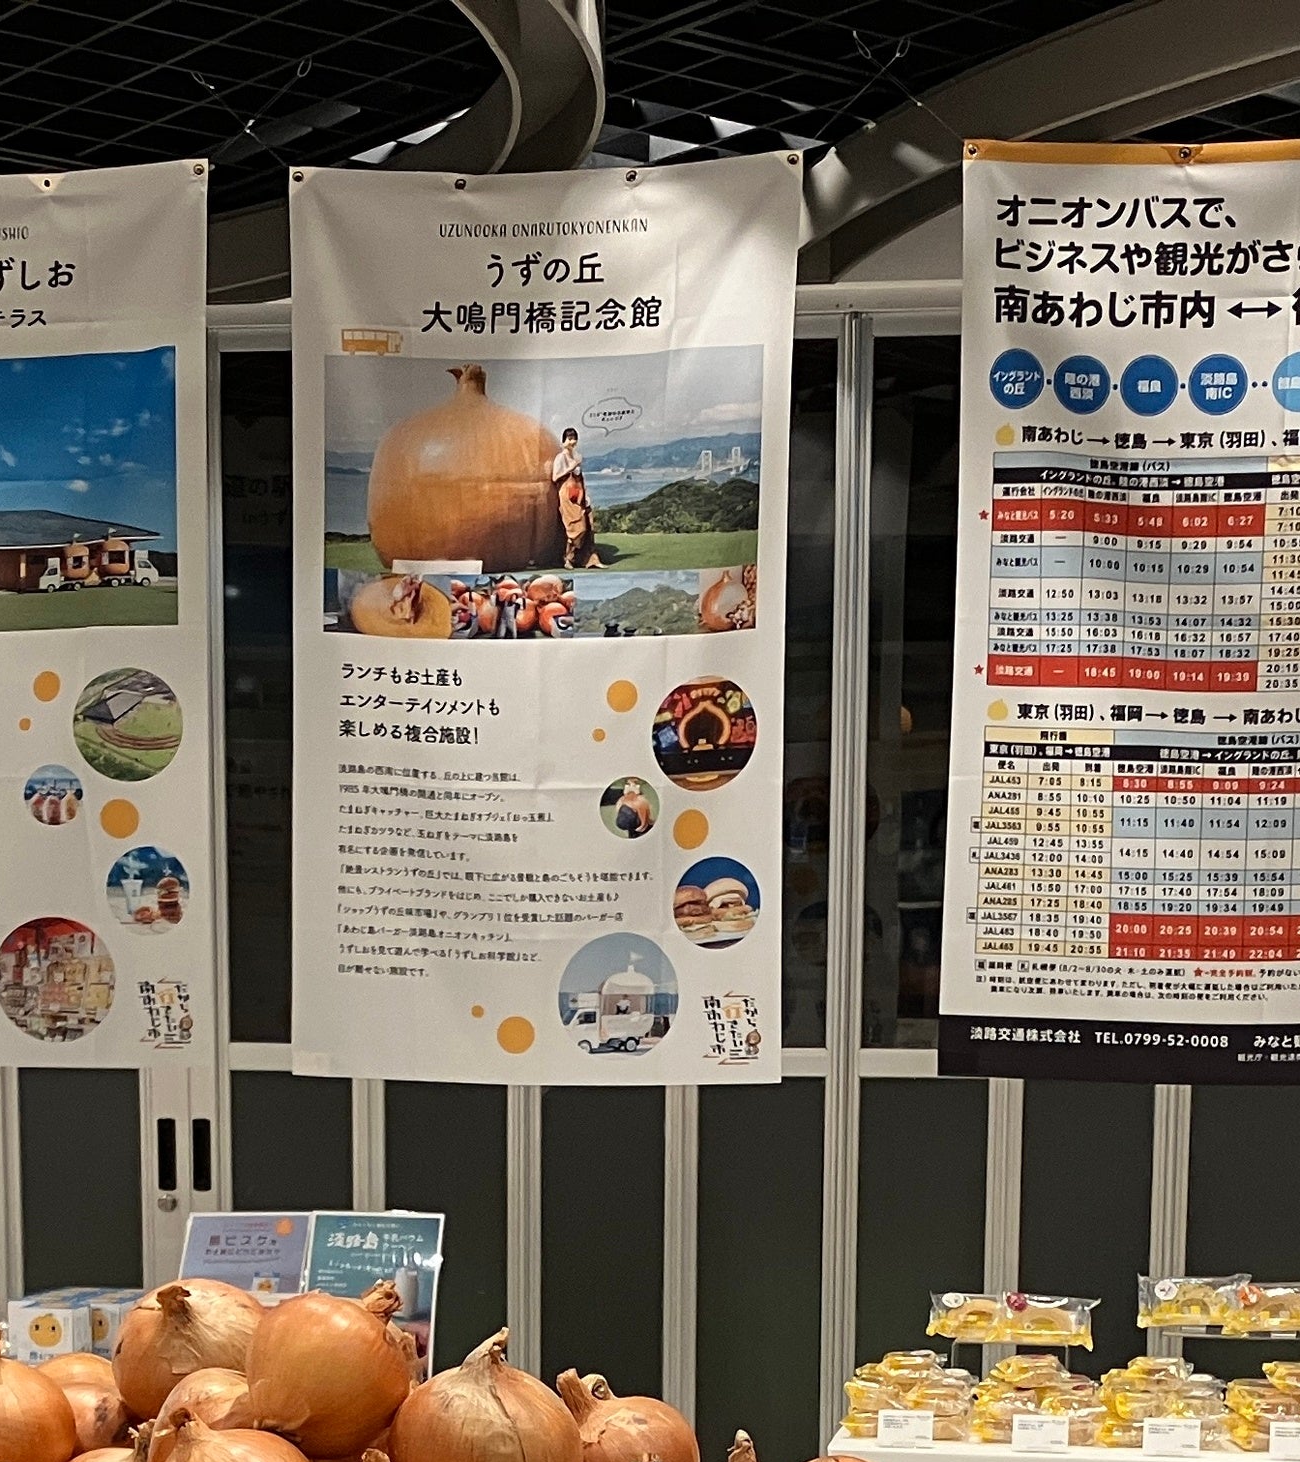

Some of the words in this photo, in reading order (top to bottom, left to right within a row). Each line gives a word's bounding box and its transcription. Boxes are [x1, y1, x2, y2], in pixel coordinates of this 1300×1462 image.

[996, 196, 1238, 230] オニオンバスで、
[439, 223, 507, 238] UZUNOOKA
[486, 252, 604, 287] うずの丘
[993, 283, 1216, 330] 南あわじ市内
[421, 296, 662, 334] 大鳴門橋記念館
[1003, 383, 1025, 396] の丘
[1022, 426, 1083, 444] 南あわじ
[1277, 522, 1300, 532] 7:10
[1223, 564, 1254, 574] 10:54
[1046, 589, 1074, 599] 12:50
[1268, 631, 1300, 642] 17:40
[1046, 642, 1073, 653] 17:25
[342, 663, 463, 687] ランチもお土産も
[1266, 664, 1299, 673] 20:15
[1265, 679, 1298, 689] 20:35
[340, 693, 500, 717] エンターテインメントも
[339, 720, 479, 745] 楽しめる複合施設！
[1120, 795, 1150, 804] 10:25
[1164, 796, 1196, 805] 10:50
[1210, 796, 1241, 806] 11:04
[1257, 796, 1287, 805] 11:19
[1120, 818, 1148, 828] 11:15
[1164, 818, 1194, 828] 11:40
[1209, 819, 1240, 828] 11:54
[1118, 886, 1147, 895] 17:15
[970, 1026, 1081, 1044] 淡路交通株式会社
[1095, 1031, 1229, 1048] TEL.0799-52-0008
